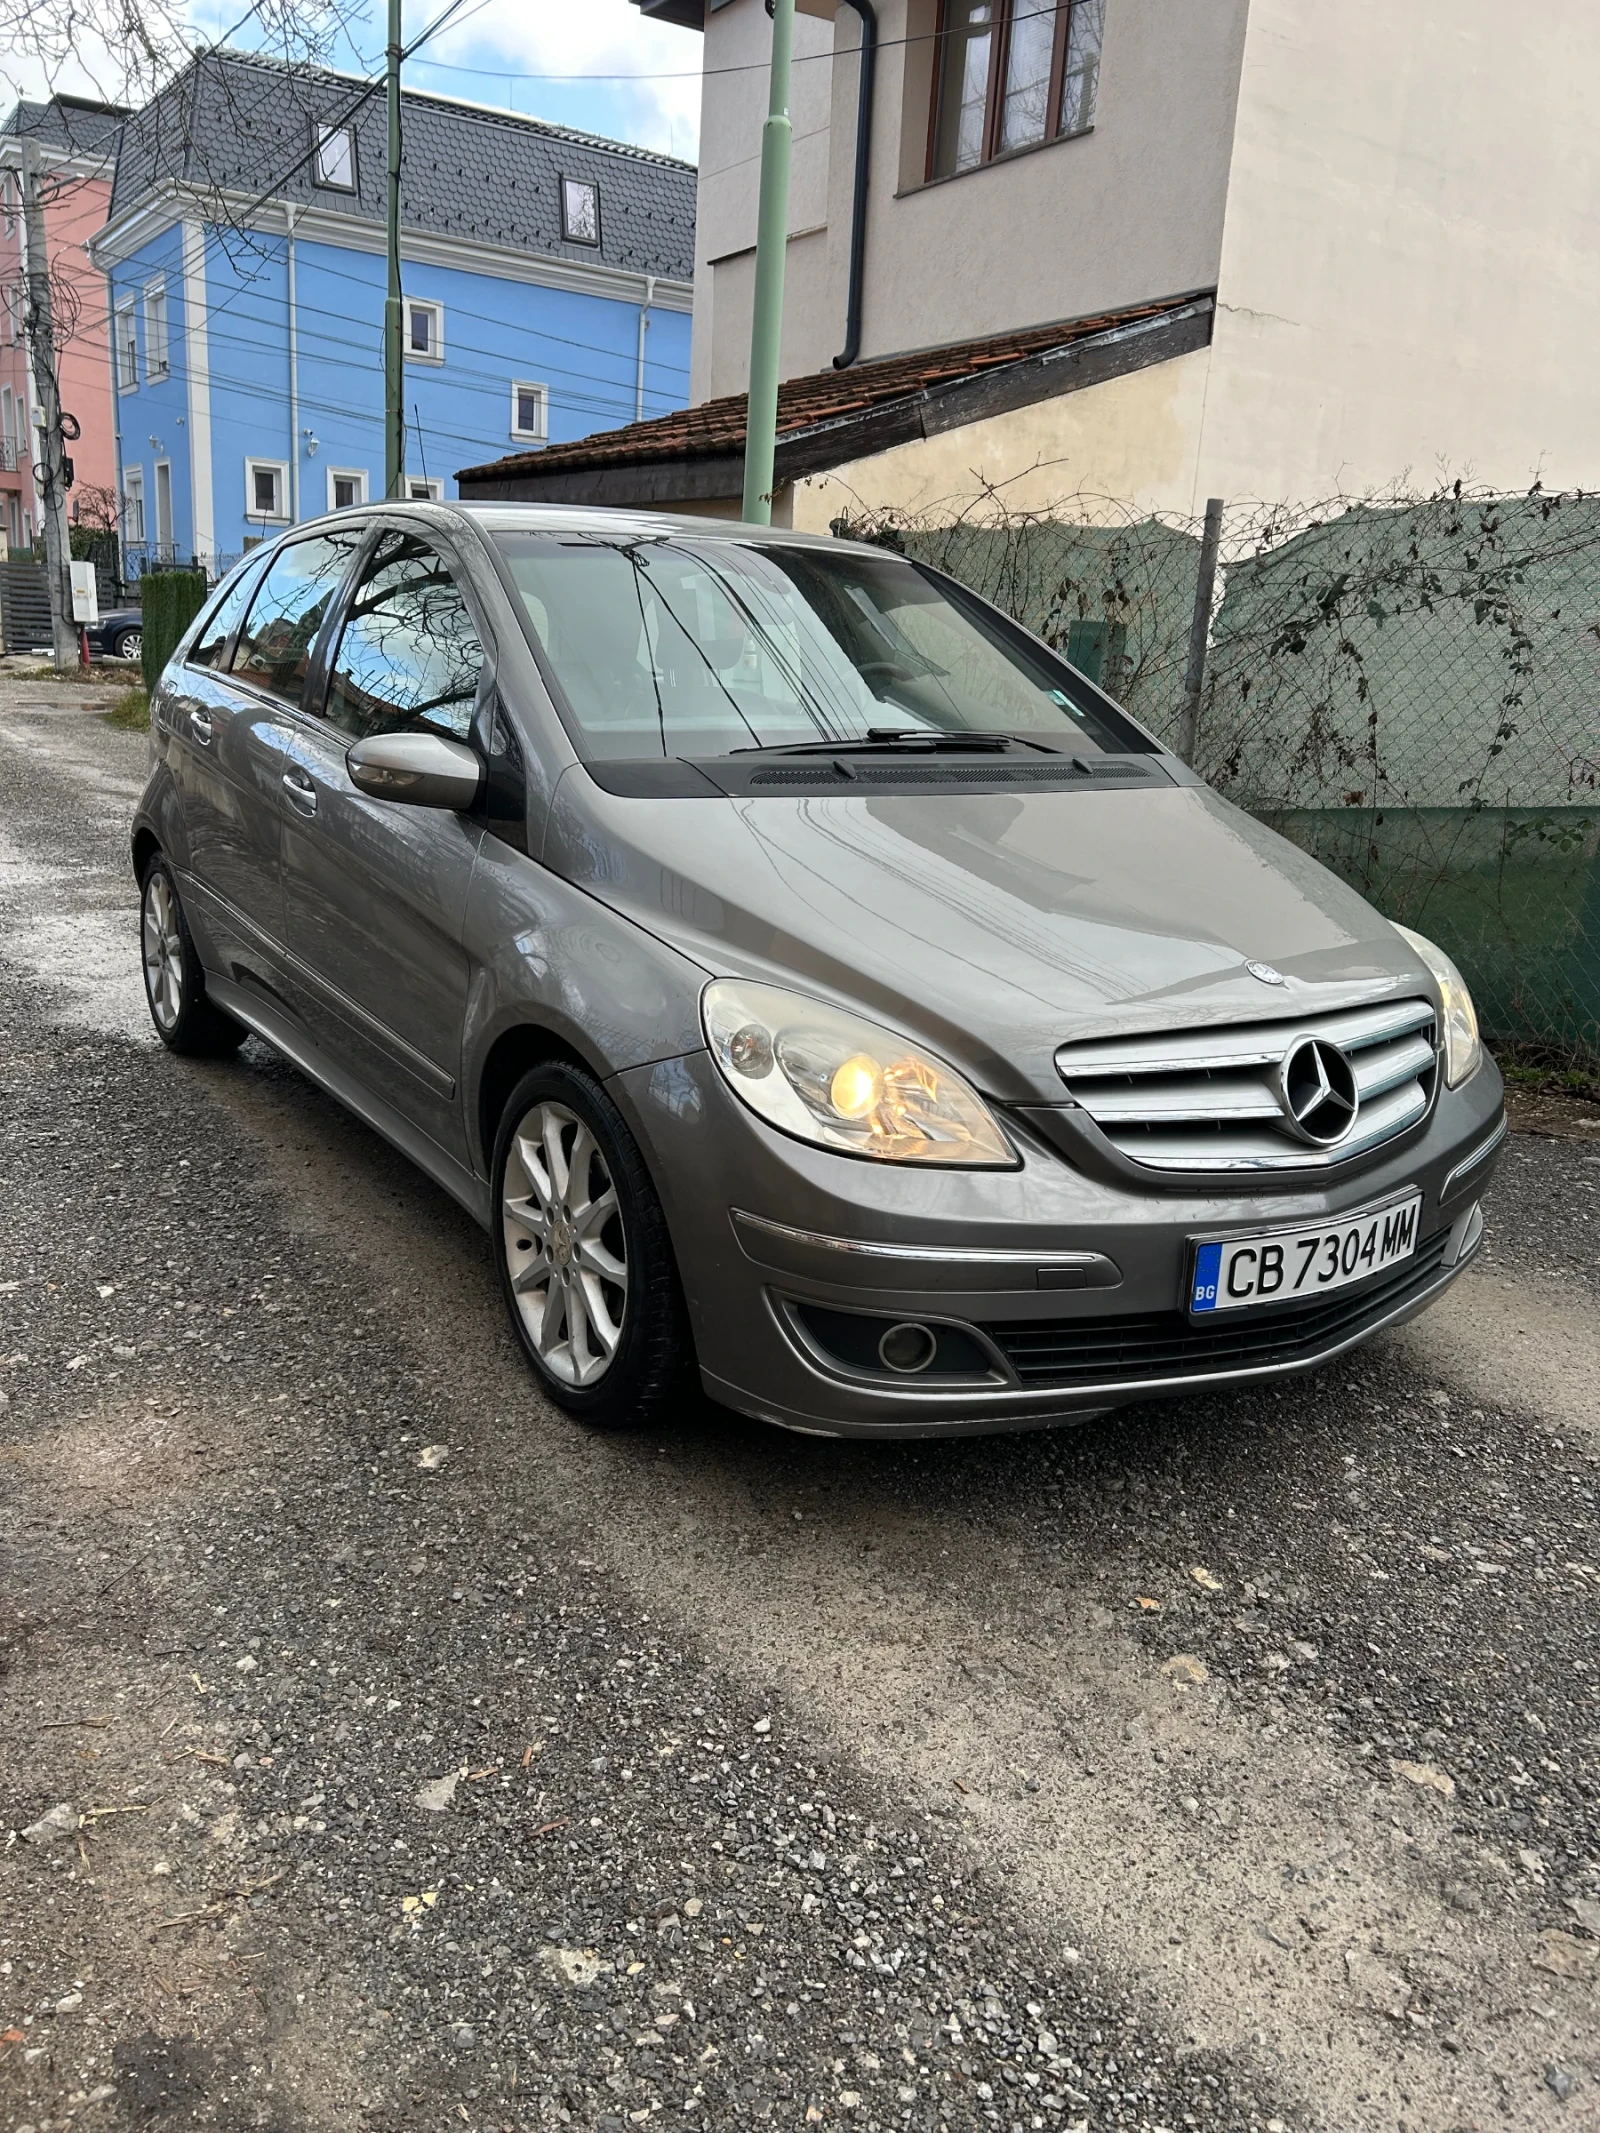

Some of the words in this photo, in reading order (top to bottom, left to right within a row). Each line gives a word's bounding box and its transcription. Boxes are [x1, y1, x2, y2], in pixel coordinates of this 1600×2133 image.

[1227, 1244, 1284, 1298] CB
[1293, 1220, 1378, 1289] 7304
[1380, 1203, 1417, 1262] MM
[1195, 1285, 1216, 1300] BG
